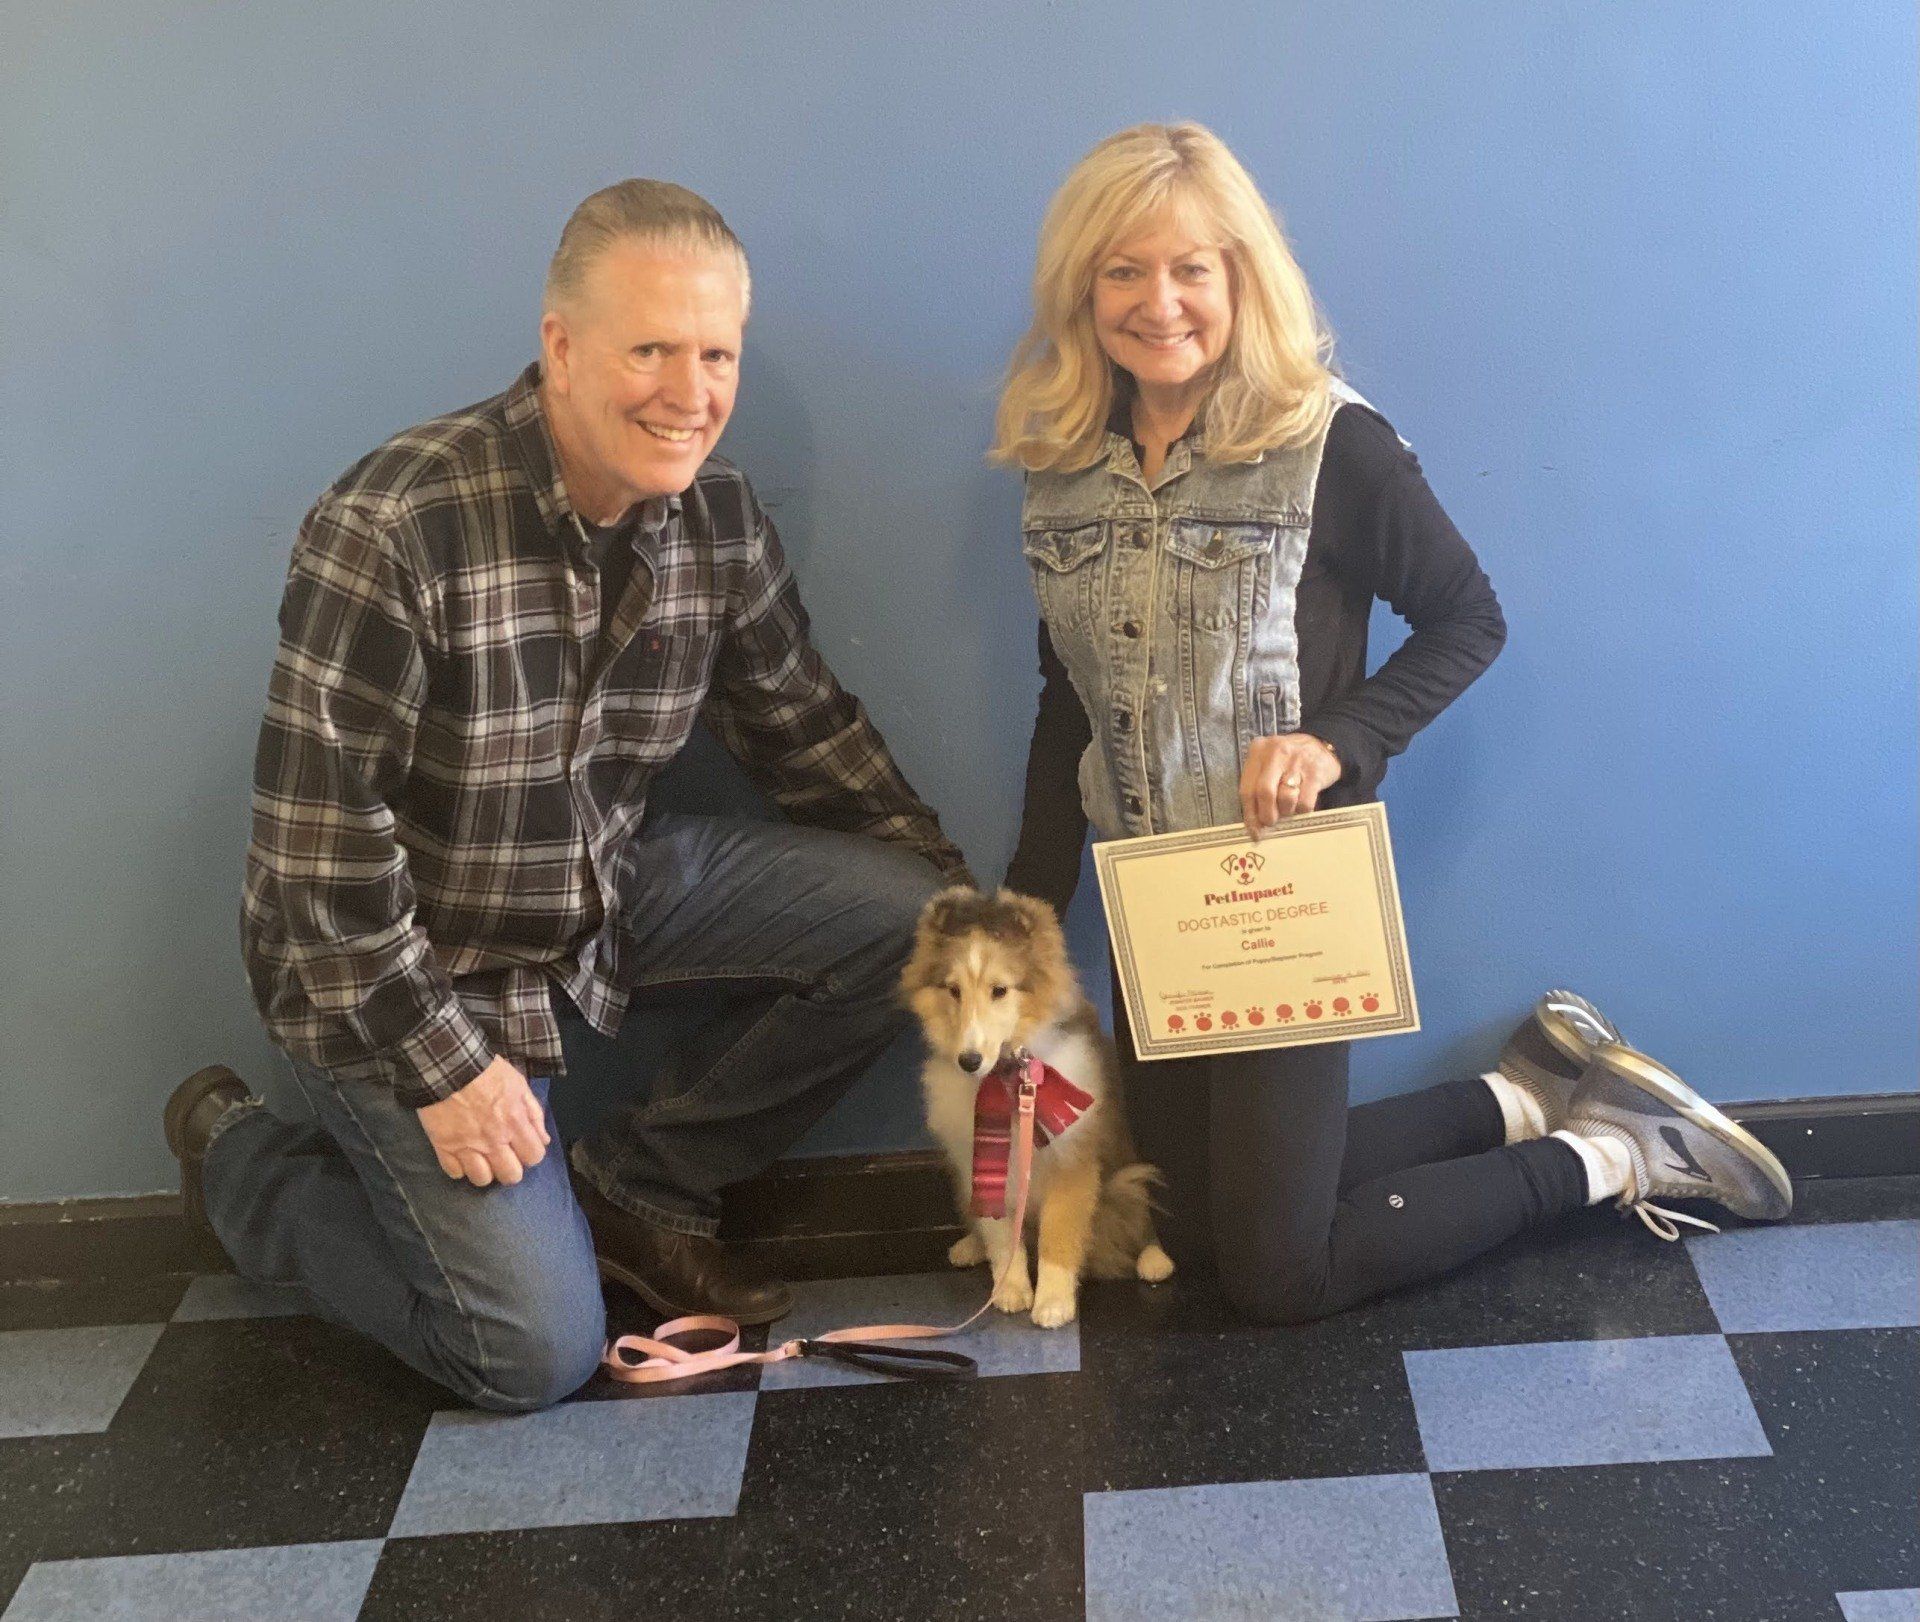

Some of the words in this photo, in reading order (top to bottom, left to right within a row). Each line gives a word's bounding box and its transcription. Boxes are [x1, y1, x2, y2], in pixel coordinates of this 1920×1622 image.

[1204, 883, 1295, 906] PetImpact!
[1177, 911, 1263, 933] DOGTASTIC
[1266, 901, 1330, 922] DEGREE
[1241, 938, 1276, 951] Callie
